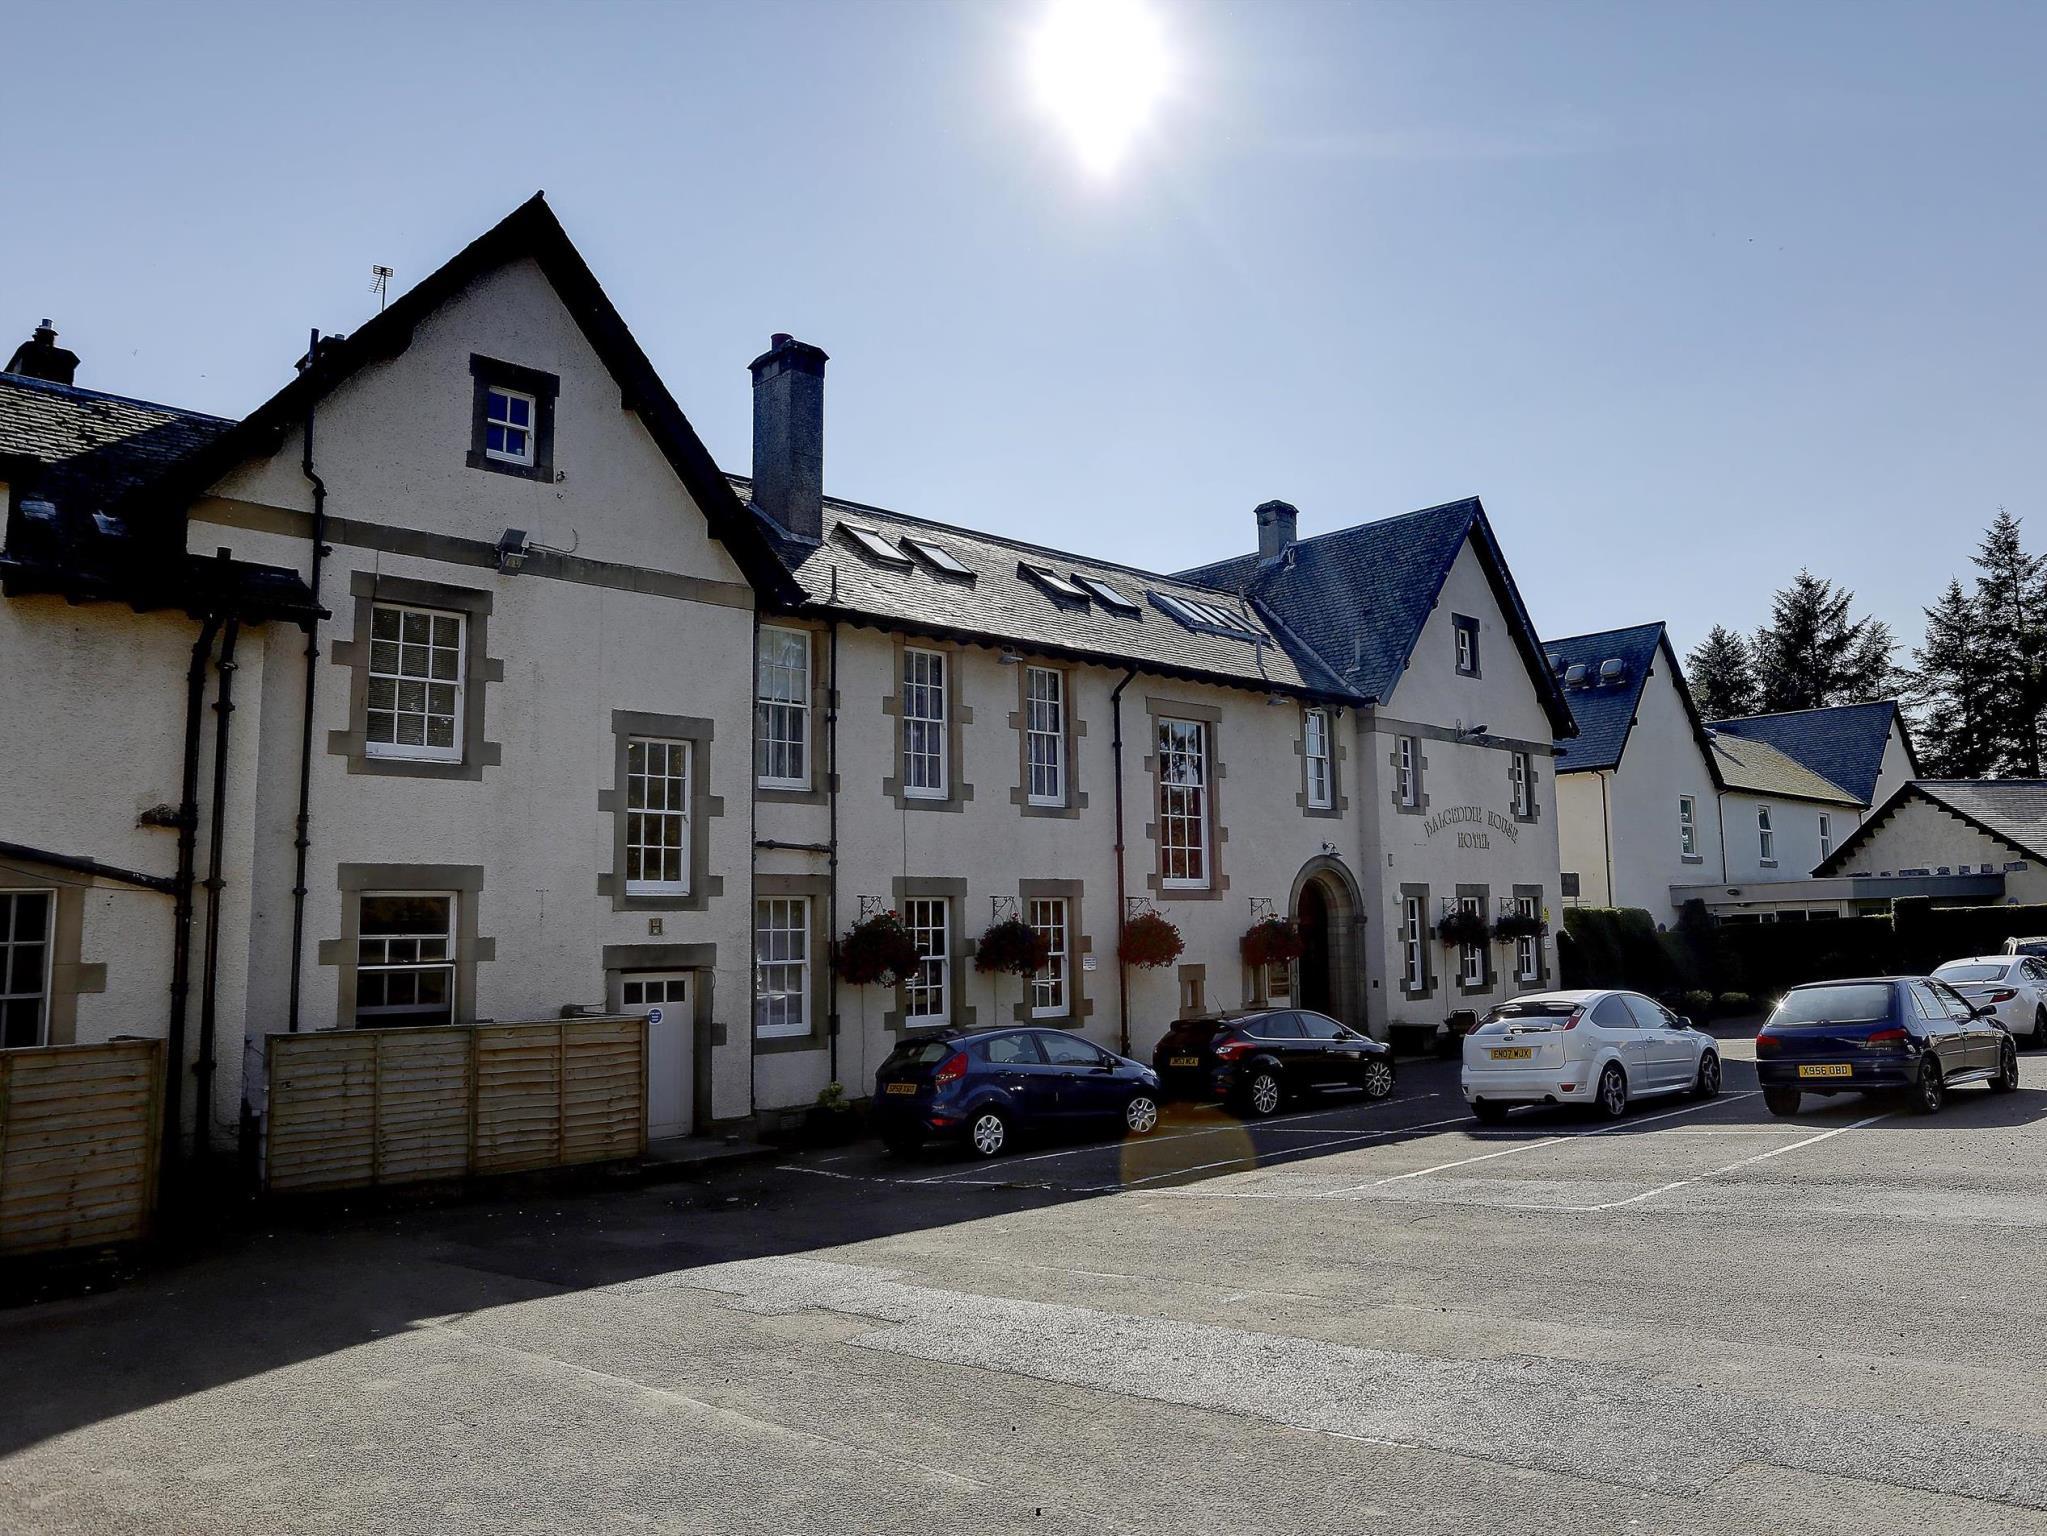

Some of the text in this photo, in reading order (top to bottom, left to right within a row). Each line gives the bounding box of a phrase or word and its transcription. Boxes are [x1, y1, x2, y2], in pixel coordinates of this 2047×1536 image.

[1423, 806, 1519, 844] BALGEDDIE HOUSE
[1457, 832, 1490, 850] HOTEL
[1803, 1065, 1827, 1076] X956
